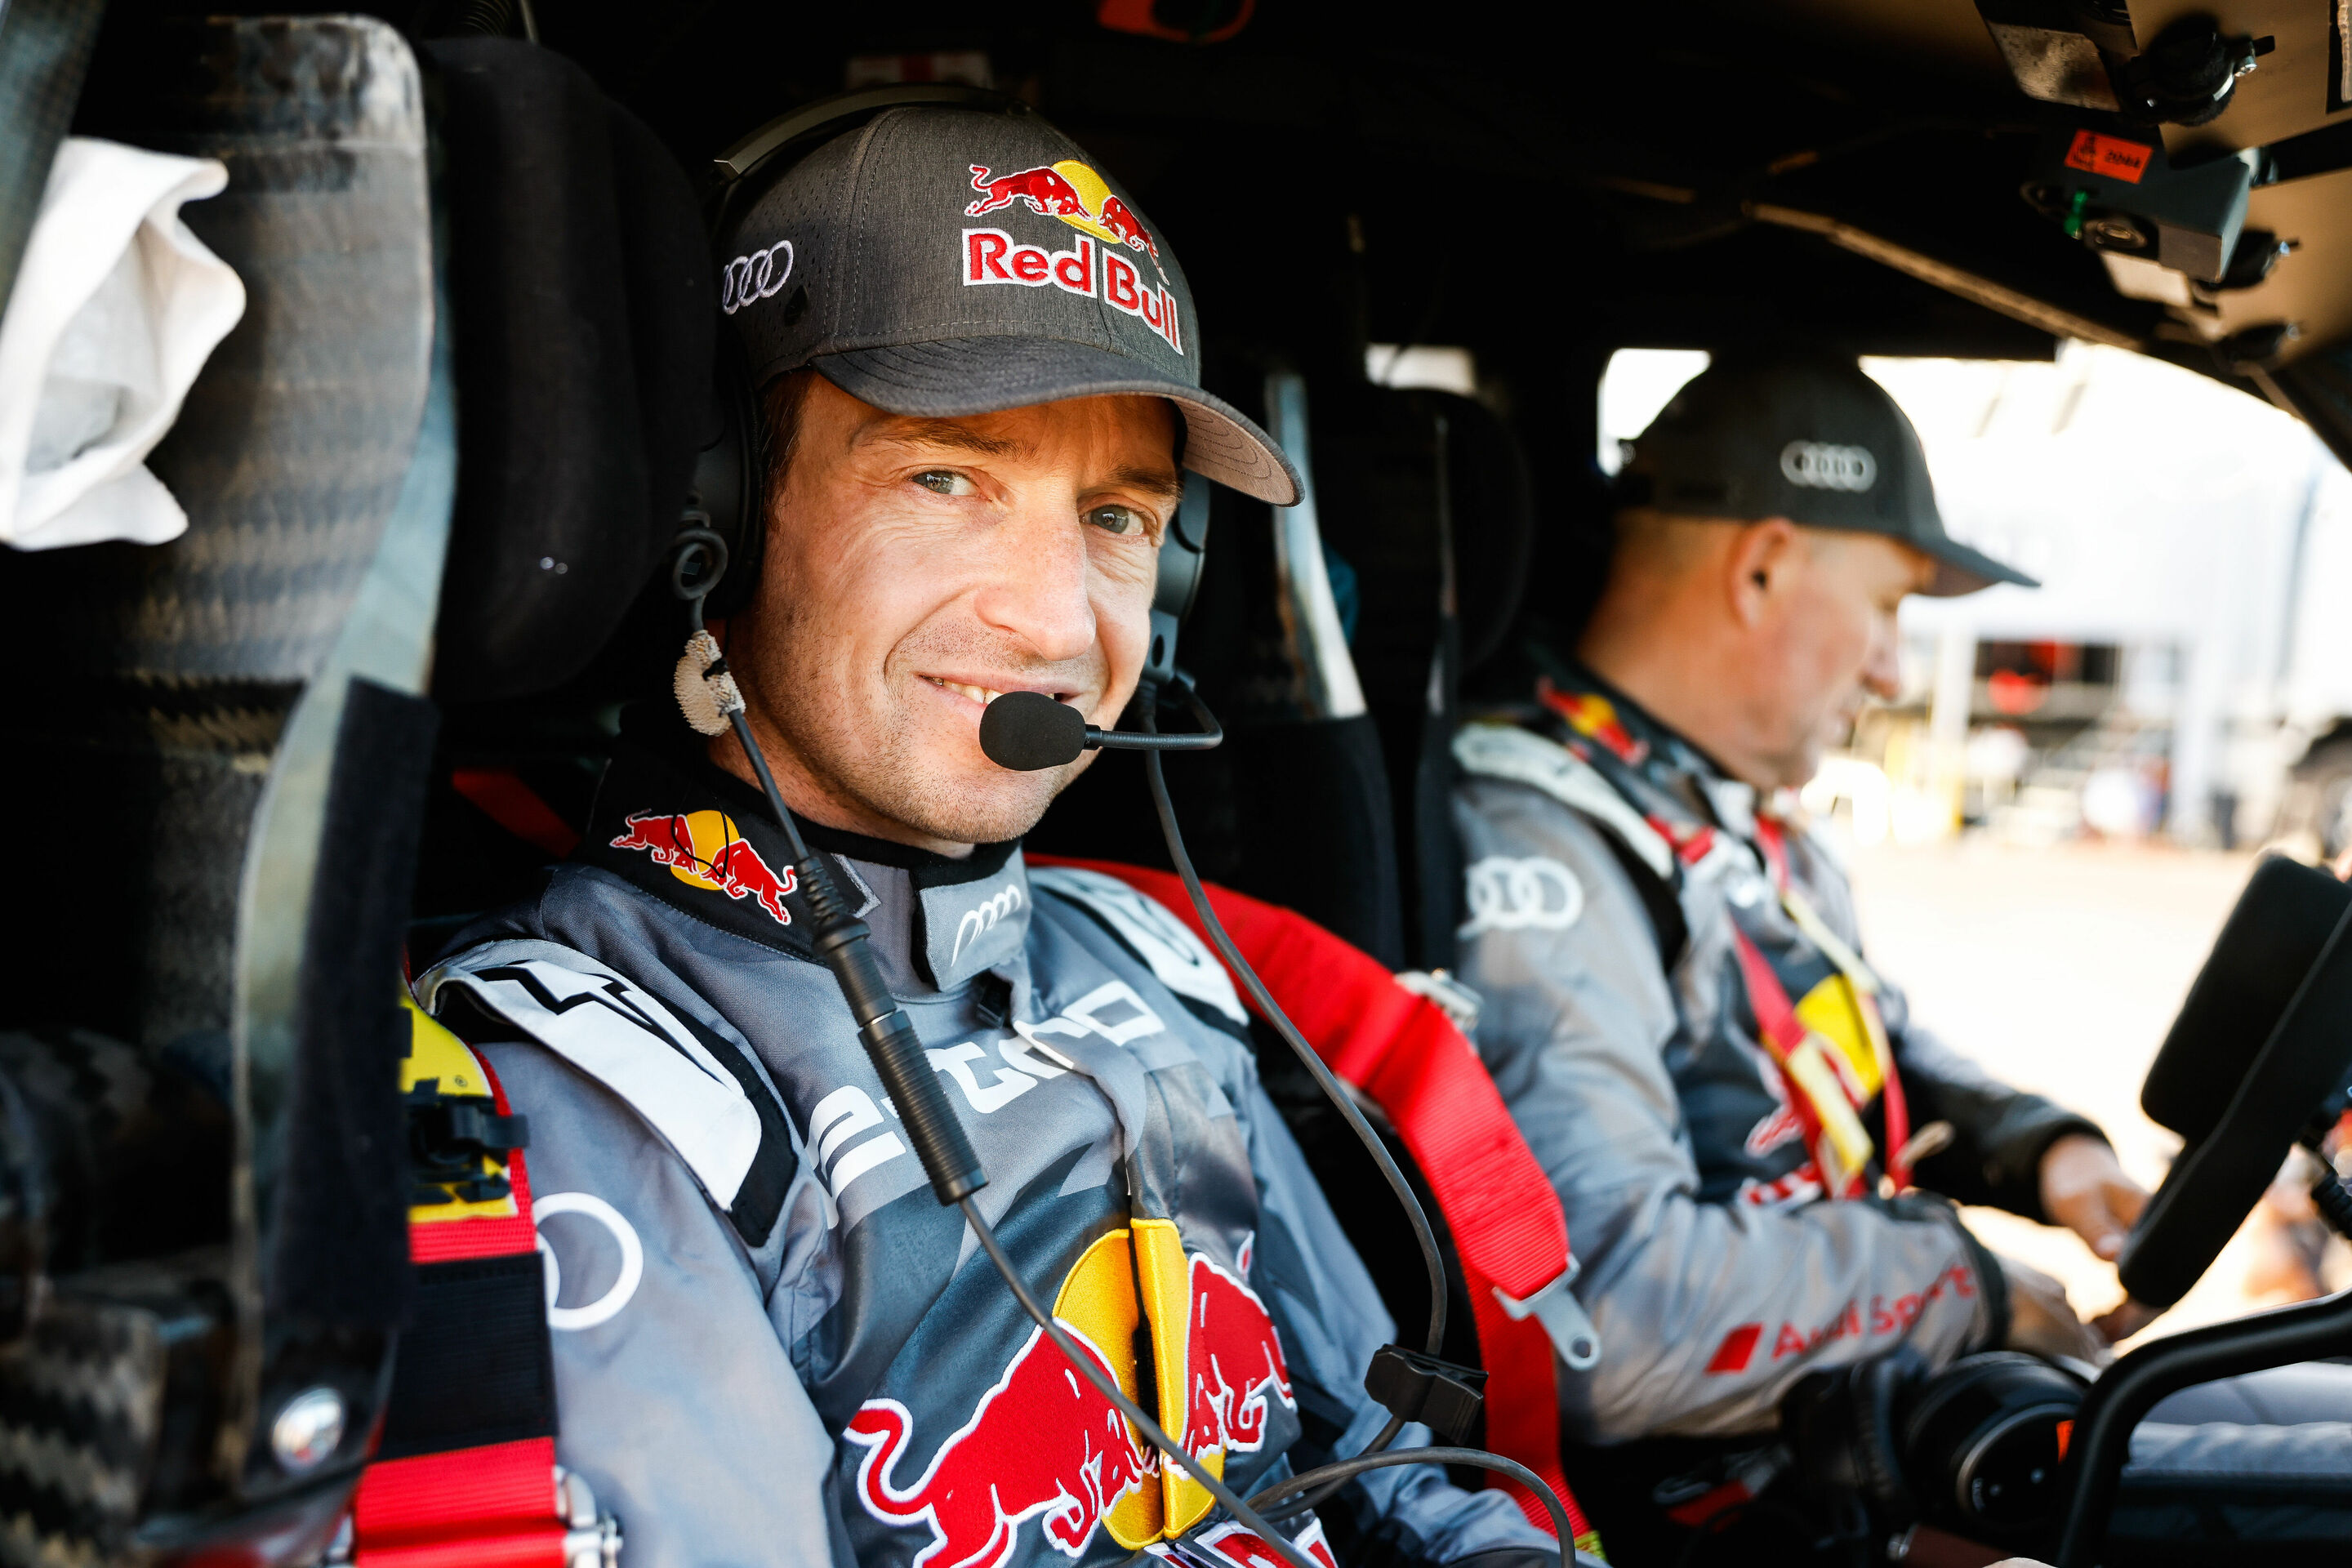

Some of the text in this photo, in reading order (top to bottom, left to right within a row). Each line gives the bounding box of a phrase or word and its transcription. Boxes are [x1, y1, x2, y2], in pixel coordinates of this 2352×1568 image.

[964, 229, 1182, 354] Red Bull
[1771, 1296, 1863, 1362] Audi
